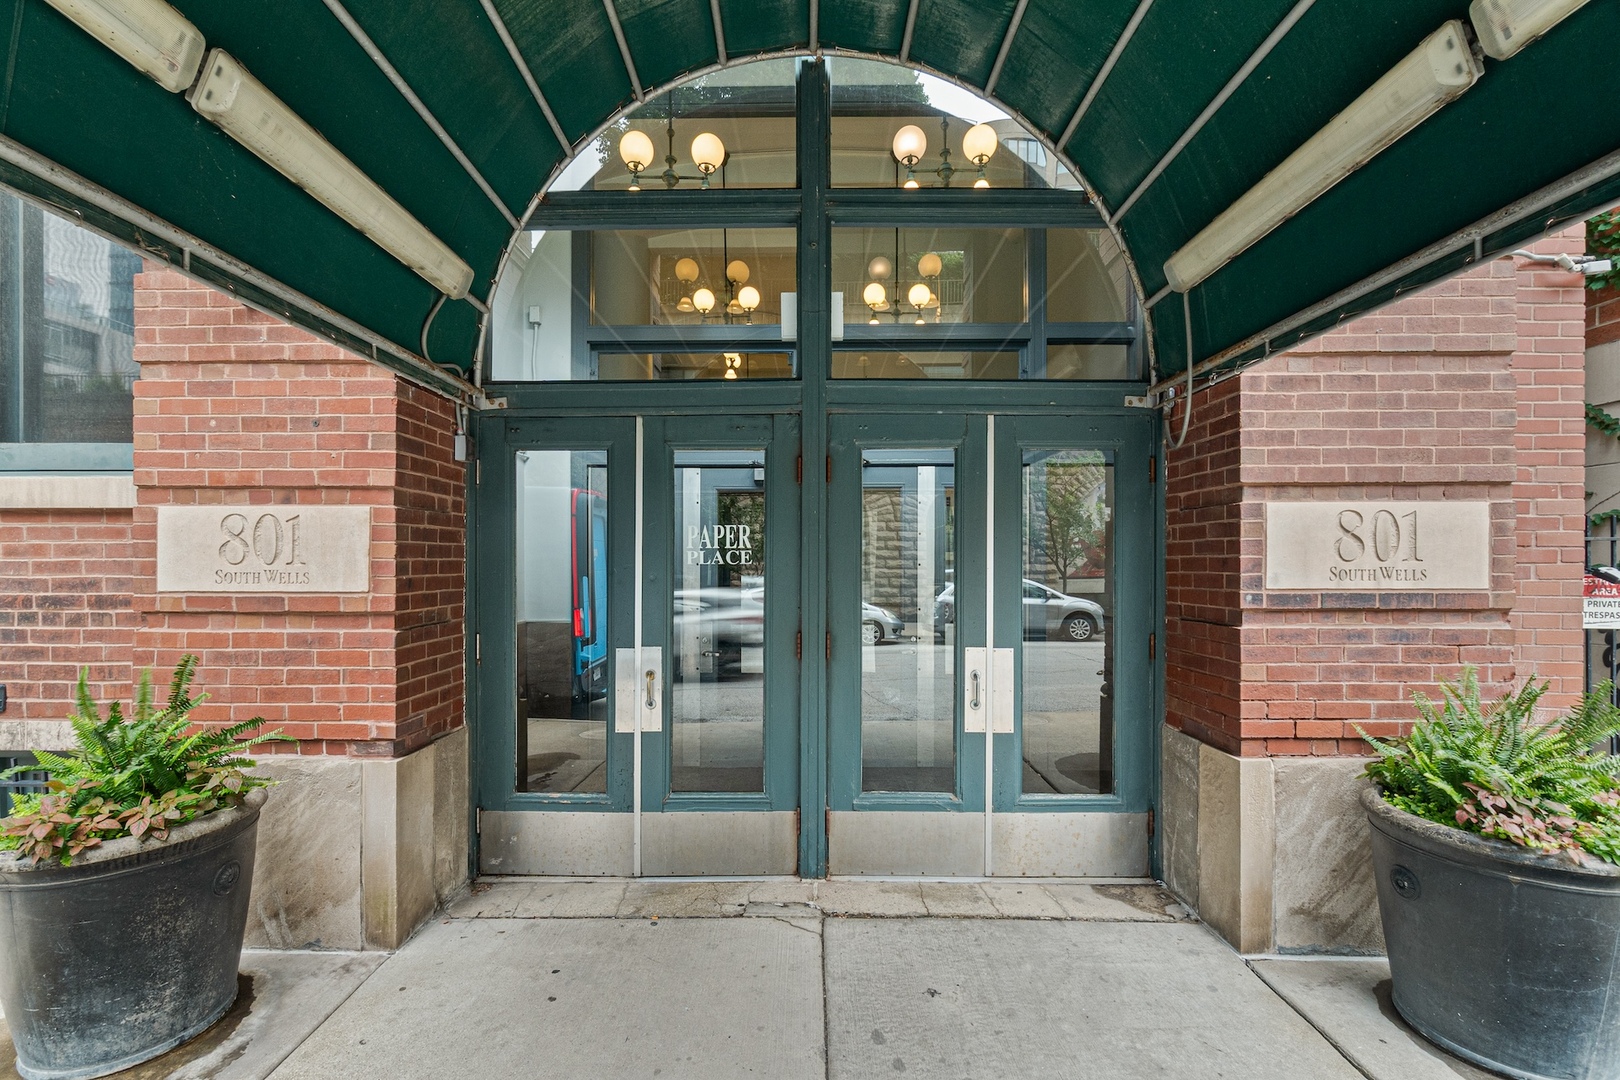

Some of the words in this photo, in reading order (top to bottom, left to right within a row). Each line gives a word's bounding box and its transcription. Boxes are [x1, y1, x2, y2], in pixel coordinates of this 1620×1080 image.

[218, 513, 307, 566] 801
[686, 524, 752, 549] PAPER
[1333, 509, 1424, 562] 801
[686, 550, 753, 565] PLACE
[215, 569, 261, 585] SOUTH
[263, 569, 310, 585] WELLS
[1329, 566, 1377, 582] SOUTH
[1379, 566, 1428, 582] WELLS
[1592, 588, 1618, 596] AREA
